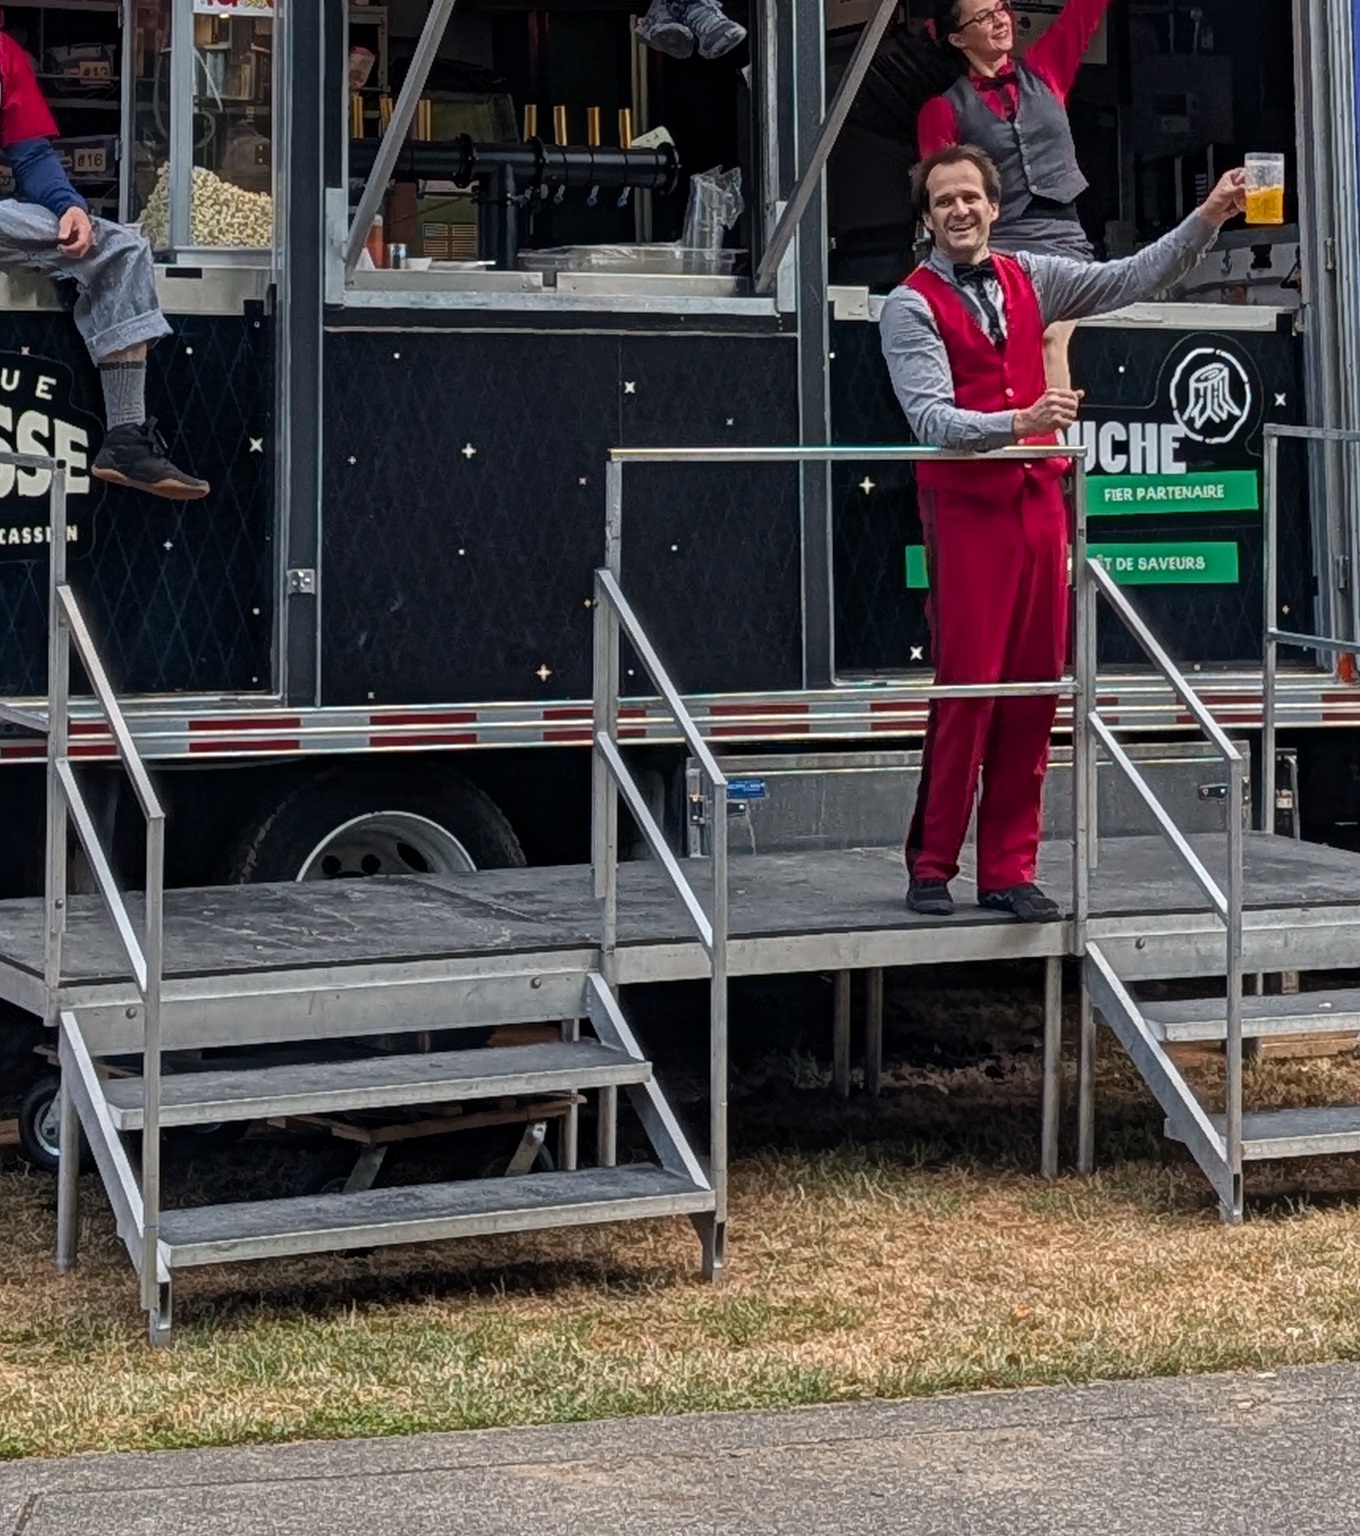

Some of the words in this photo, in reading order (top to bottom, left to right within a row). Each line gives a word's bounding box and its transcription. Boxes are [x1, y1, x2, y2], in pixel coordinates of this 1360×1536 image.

[1104, 487, 1134, 502] FIER
[1136, 484, 1226, 501] PARTENAIRE
[1115, 557, 1134, 571] DE
[1137, 555, 1206, 572] SAVEURS
